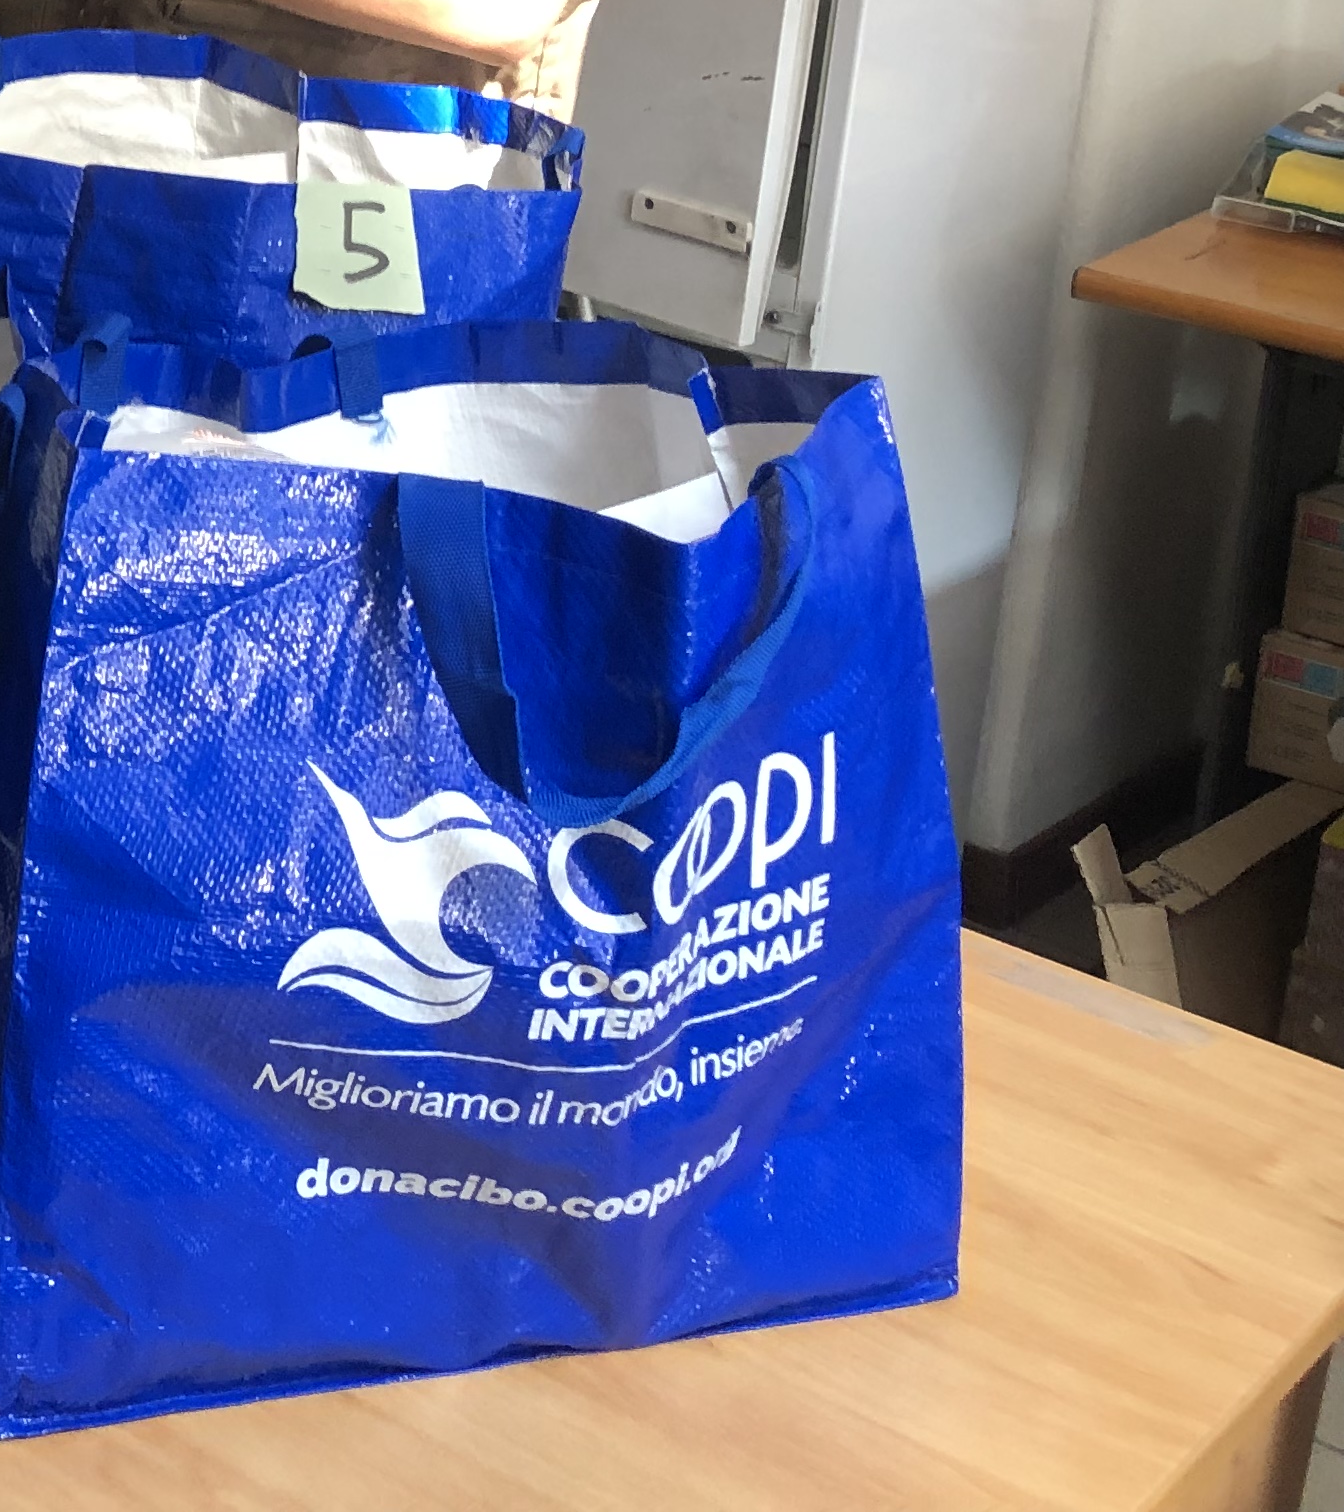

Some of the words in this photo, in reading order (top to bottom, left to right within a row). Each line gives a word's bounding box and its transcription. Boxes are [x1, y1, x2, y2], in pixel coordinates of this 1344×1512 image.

[343, 201, 390, 284] 5
[547, 731, 837, 935] COOPI
[538, 872, 831, 1003] COOPERAZIONE
[252, 1062, 521, 1123] Miglioriamo
[528, 1089, 554, 1125] il
